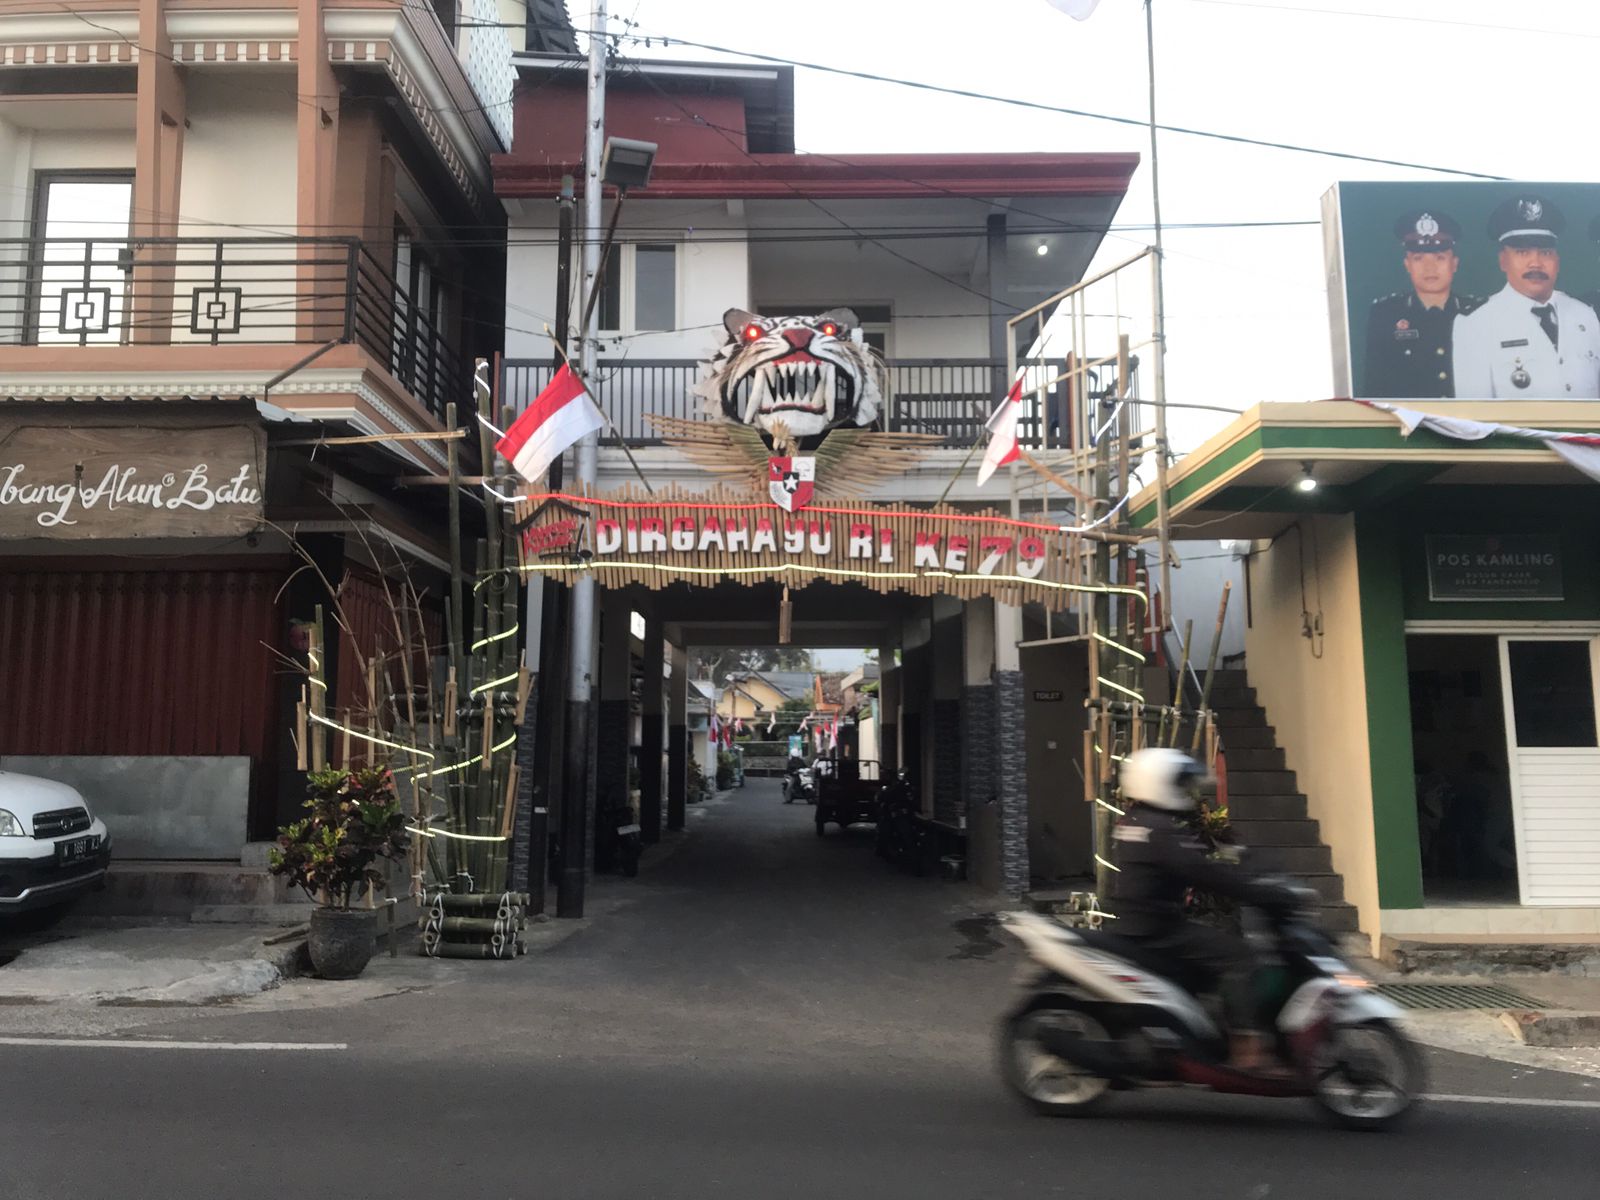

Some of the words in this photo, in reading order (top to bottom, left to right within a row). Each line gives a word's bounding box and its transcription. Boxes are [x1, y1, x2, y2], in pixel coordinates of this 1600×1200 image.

[165, 463, 262, 511] Batu
[596, 515, 832, 555] DIRGAHAYU
[849, 523, 893, 563] RI
[914, 531, 969, 572] KE
[977, 536, 1046, 579] 79
[1437, 553, 1470, 566] POS
[1476, 553, 1554, 566] KAMLING
